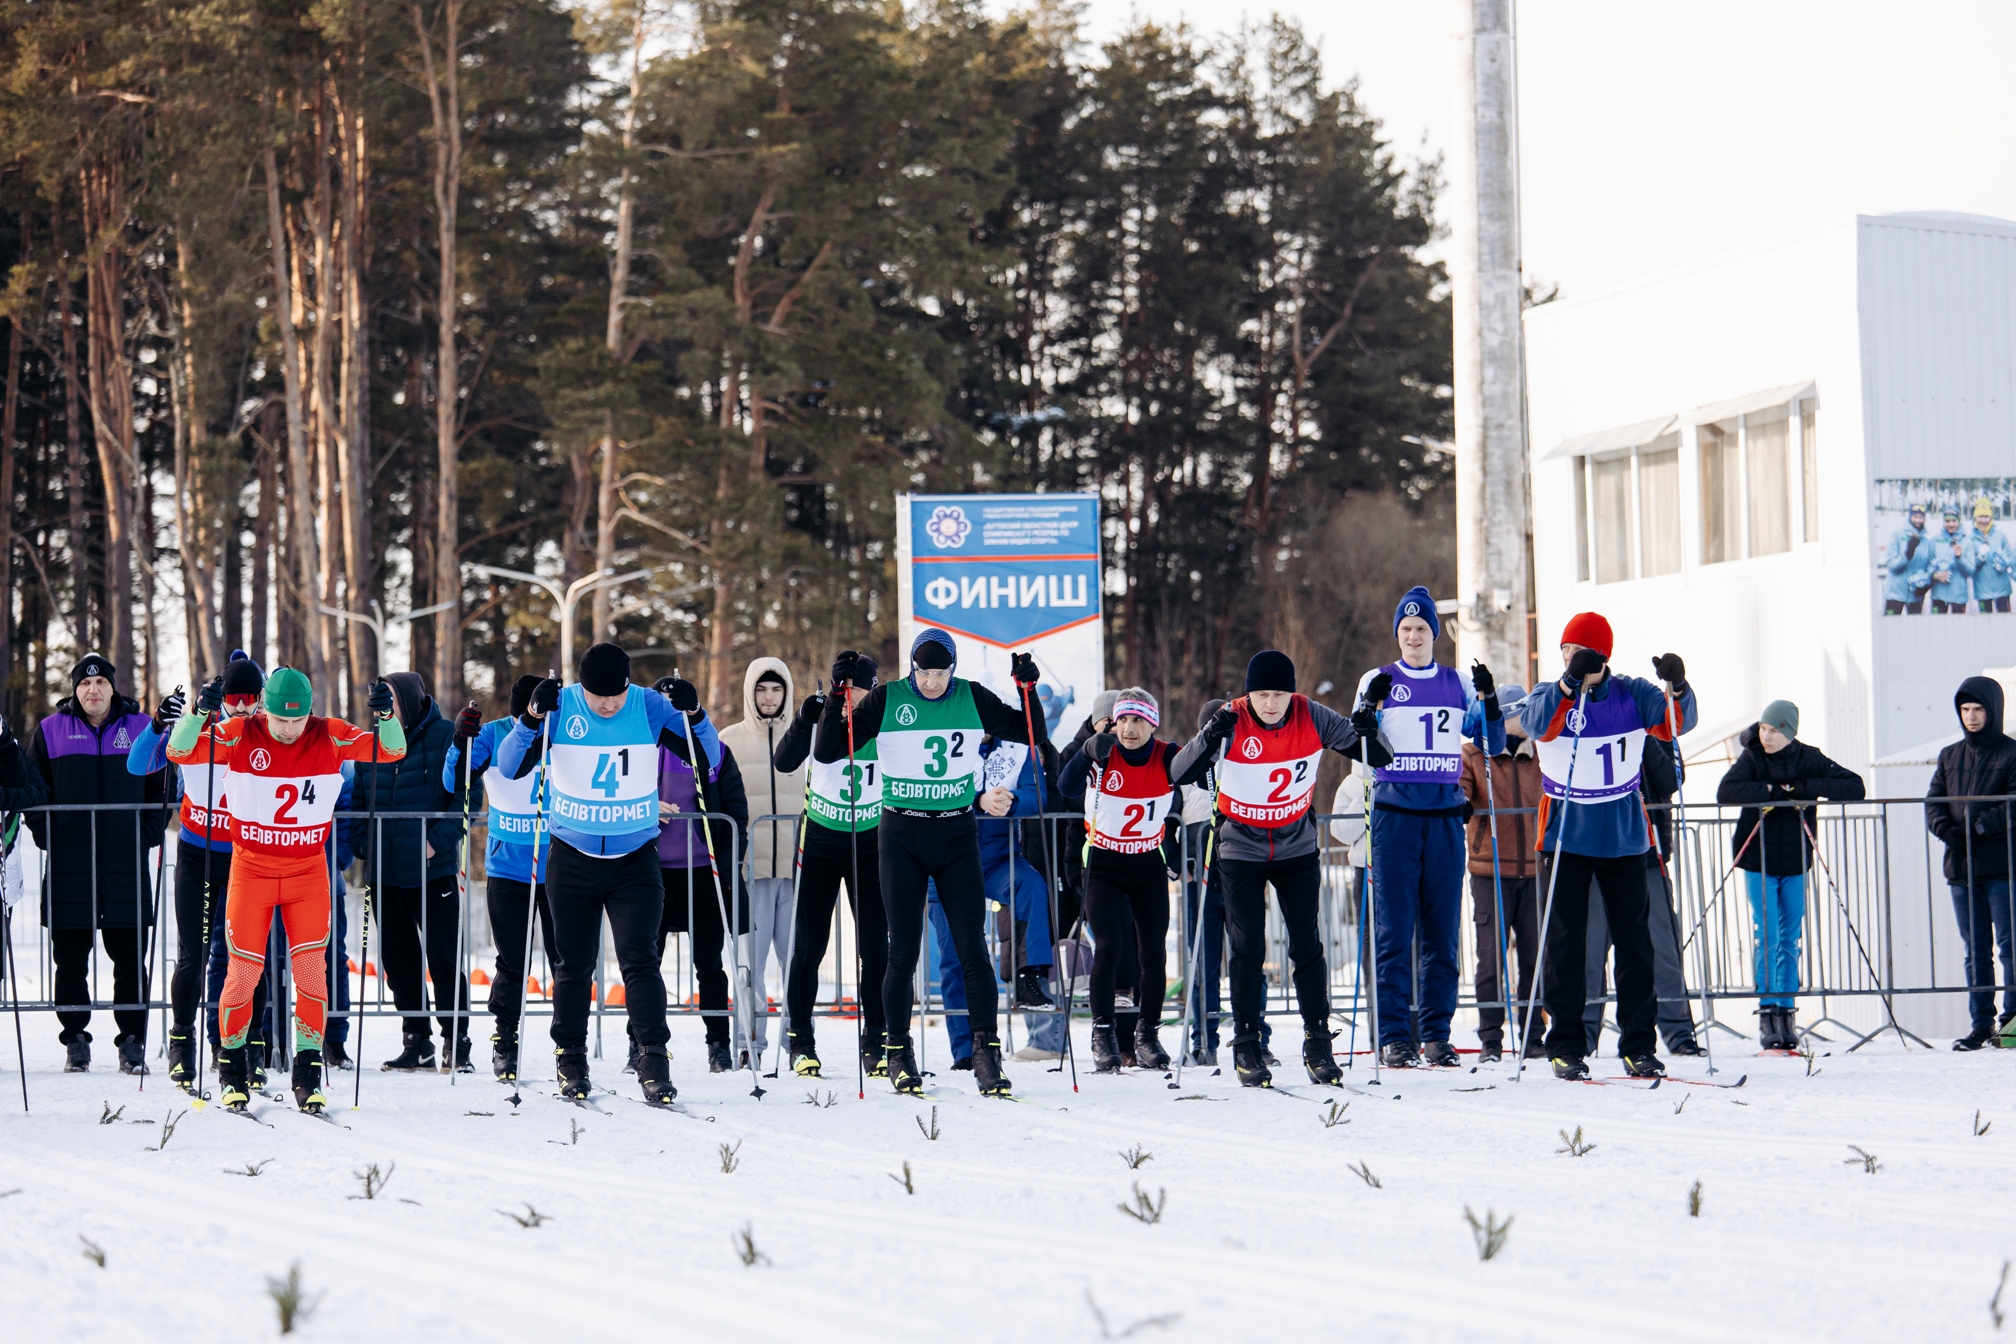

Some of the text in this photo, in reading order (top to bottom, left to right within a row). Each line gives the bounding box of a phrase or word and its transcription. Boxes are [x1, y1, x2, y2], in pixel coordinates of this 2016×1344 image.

[924, 574, 1087, 609] ФИНИШ
[1419, 709, 1450, 750] 1 2
[591, 748, 629, 798] 4 1
[924, 731, 964, 778] 3 2
[1595, 742, 1614, 786] 1
[1617, 736, 1627, 763] 1
[839, 763, 875, 803] 3 1
[1267, 760, 1308, 803] 2 2
[273, 779, 316, 825] 2 4
[554, 795, 652, 823] БЕЛВТОРМЕТ
[810, 795, 883, 823] БЕЛВТОРМЕТ
[901, 808, 931, 818] JÖGEL
[1120, 800, 1156, 837] 2 1
[1230, 790, 1311, 821] БЕЛВТОРМЕТ
[240, 824, 326, 847] БЕЛВТОРМЕТ
[499, 814, 551, 833] БЕЛВТО
